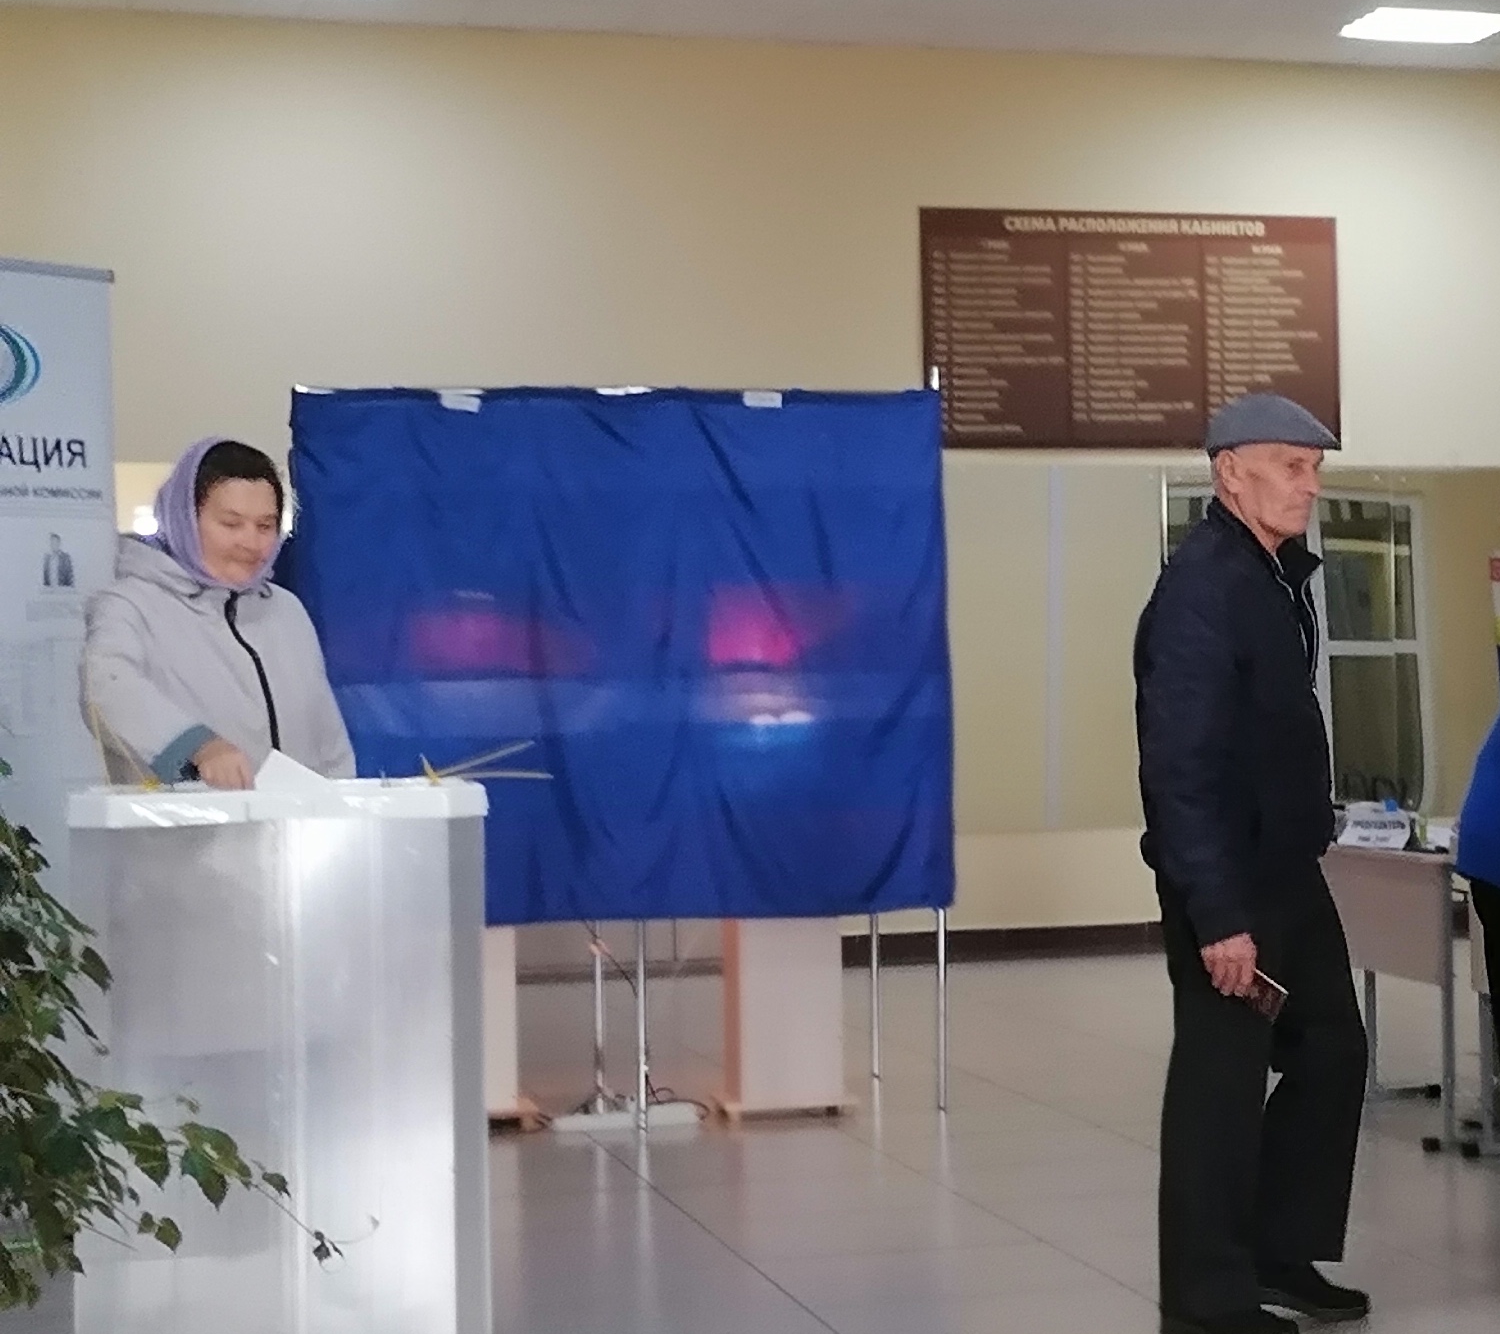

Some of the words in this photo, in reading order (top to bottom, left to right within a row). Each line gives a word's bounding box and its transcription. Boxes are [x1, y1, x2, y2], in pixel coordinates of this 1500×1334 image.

[1004, 217, 1056, 232] СХЕМА
[1058, 218, 1179, 235] РАСПОЛОЖЕНИЯ
[1181, 220, 1266, 237] КАБИНЕТОВ
[0, 436, 87, 473] АЦИЯ
